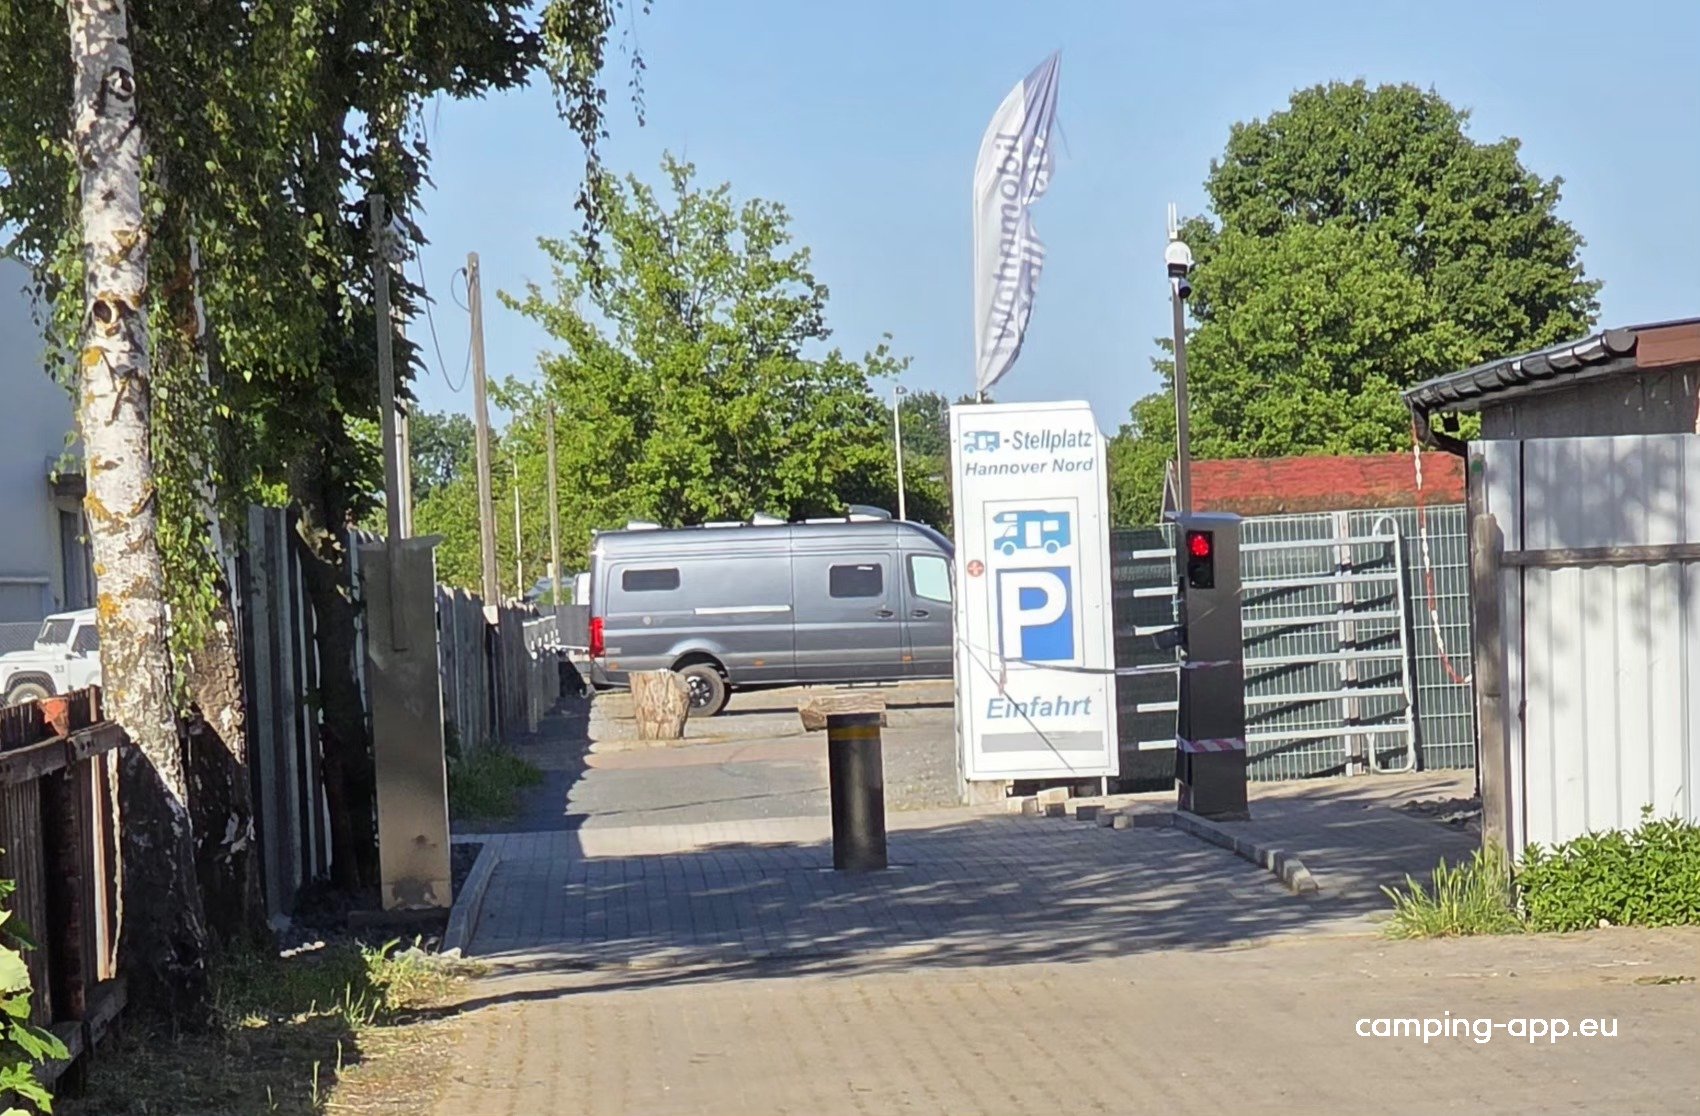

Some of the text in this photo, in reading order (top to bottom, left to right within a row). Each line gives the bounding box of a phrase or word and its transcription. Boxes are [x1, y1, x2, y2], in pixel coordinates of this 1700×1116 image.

[992, 131, 1020, 342] Wohnmobil
[965, 457, 1094, 476] Hannover Nord
[1000, 571, 1067, 659] P
[986, 695, 1092, 719] Einfahrt
